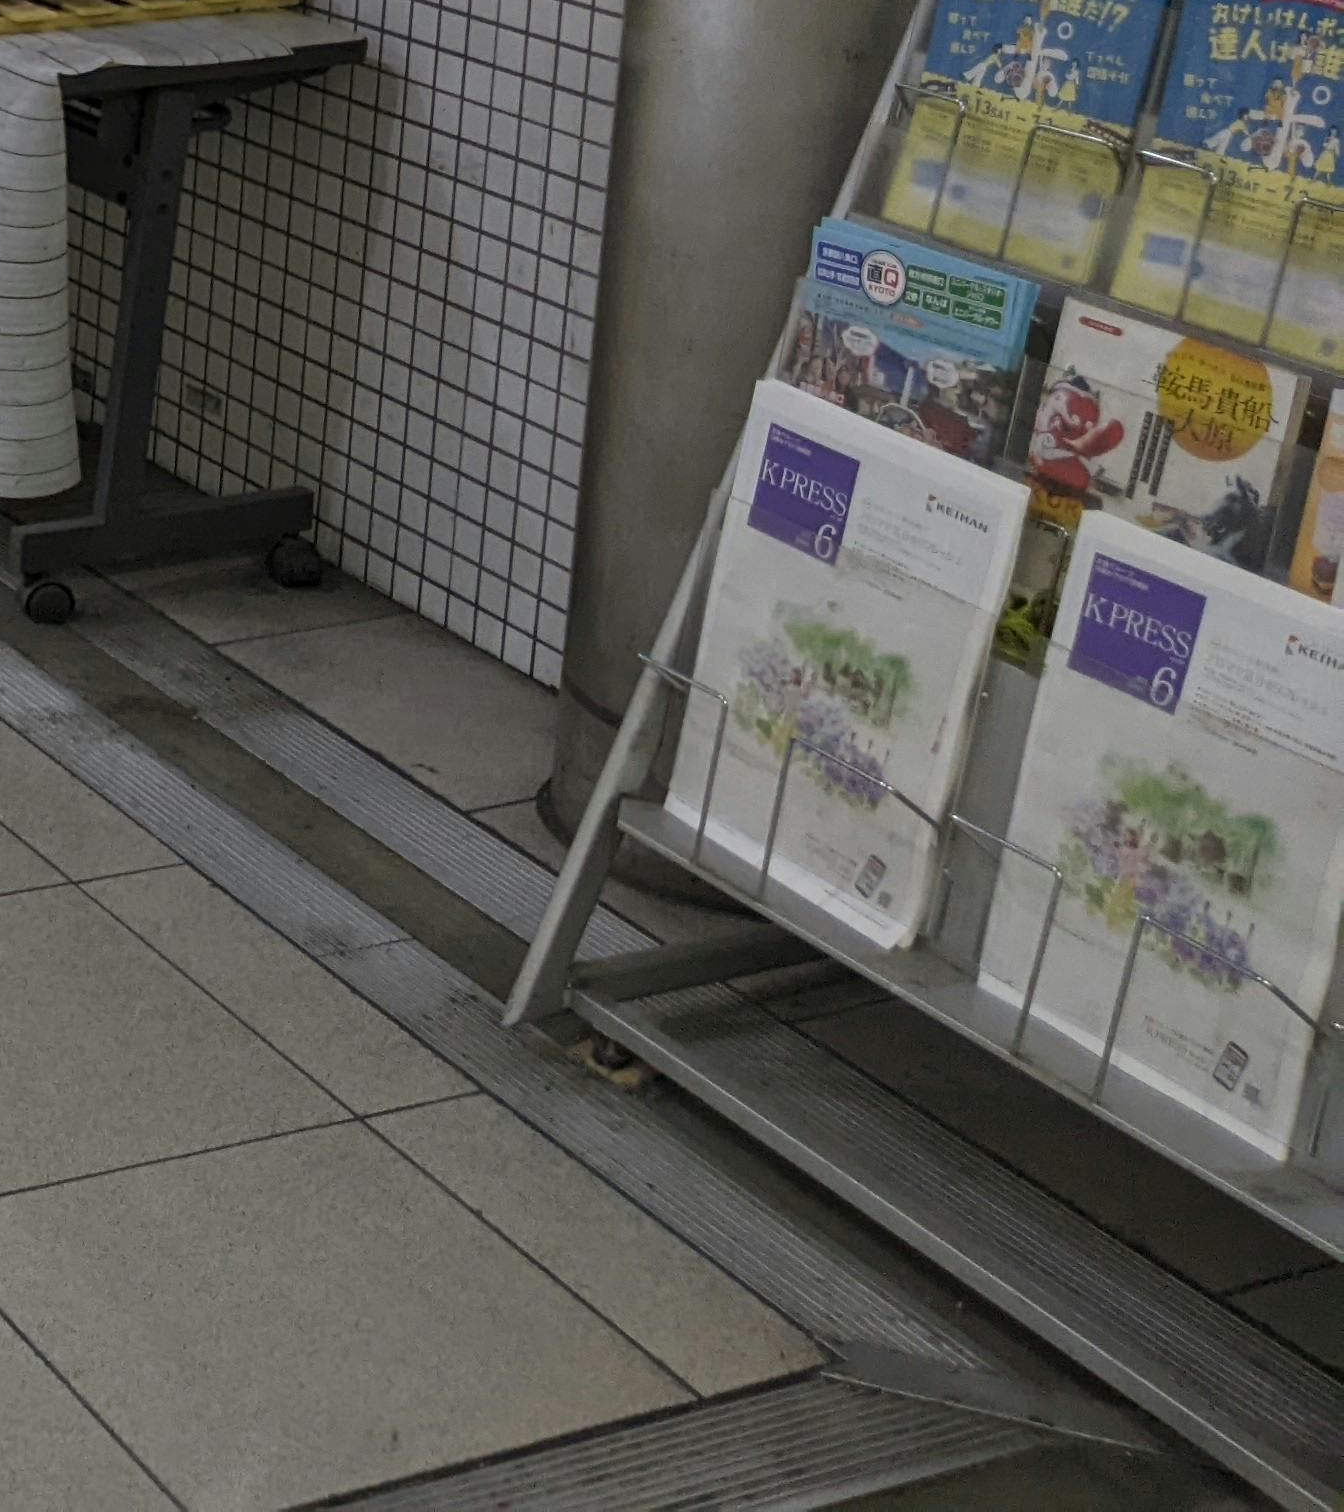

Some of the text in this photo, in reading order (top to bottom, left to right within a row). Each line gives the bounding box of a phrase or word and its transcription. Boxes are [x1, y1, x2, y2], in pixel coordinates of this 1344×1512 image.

[869, 285, 896, 298] KYOTO
[761, 458, 848, 518] K PRESS
[936, 502, 989, 534] KEIHAN
[814, 524, 837, 559] 6
[1084, 592, 1192, 659] K PRESS
[1149, 666, 1177, 706] 6
